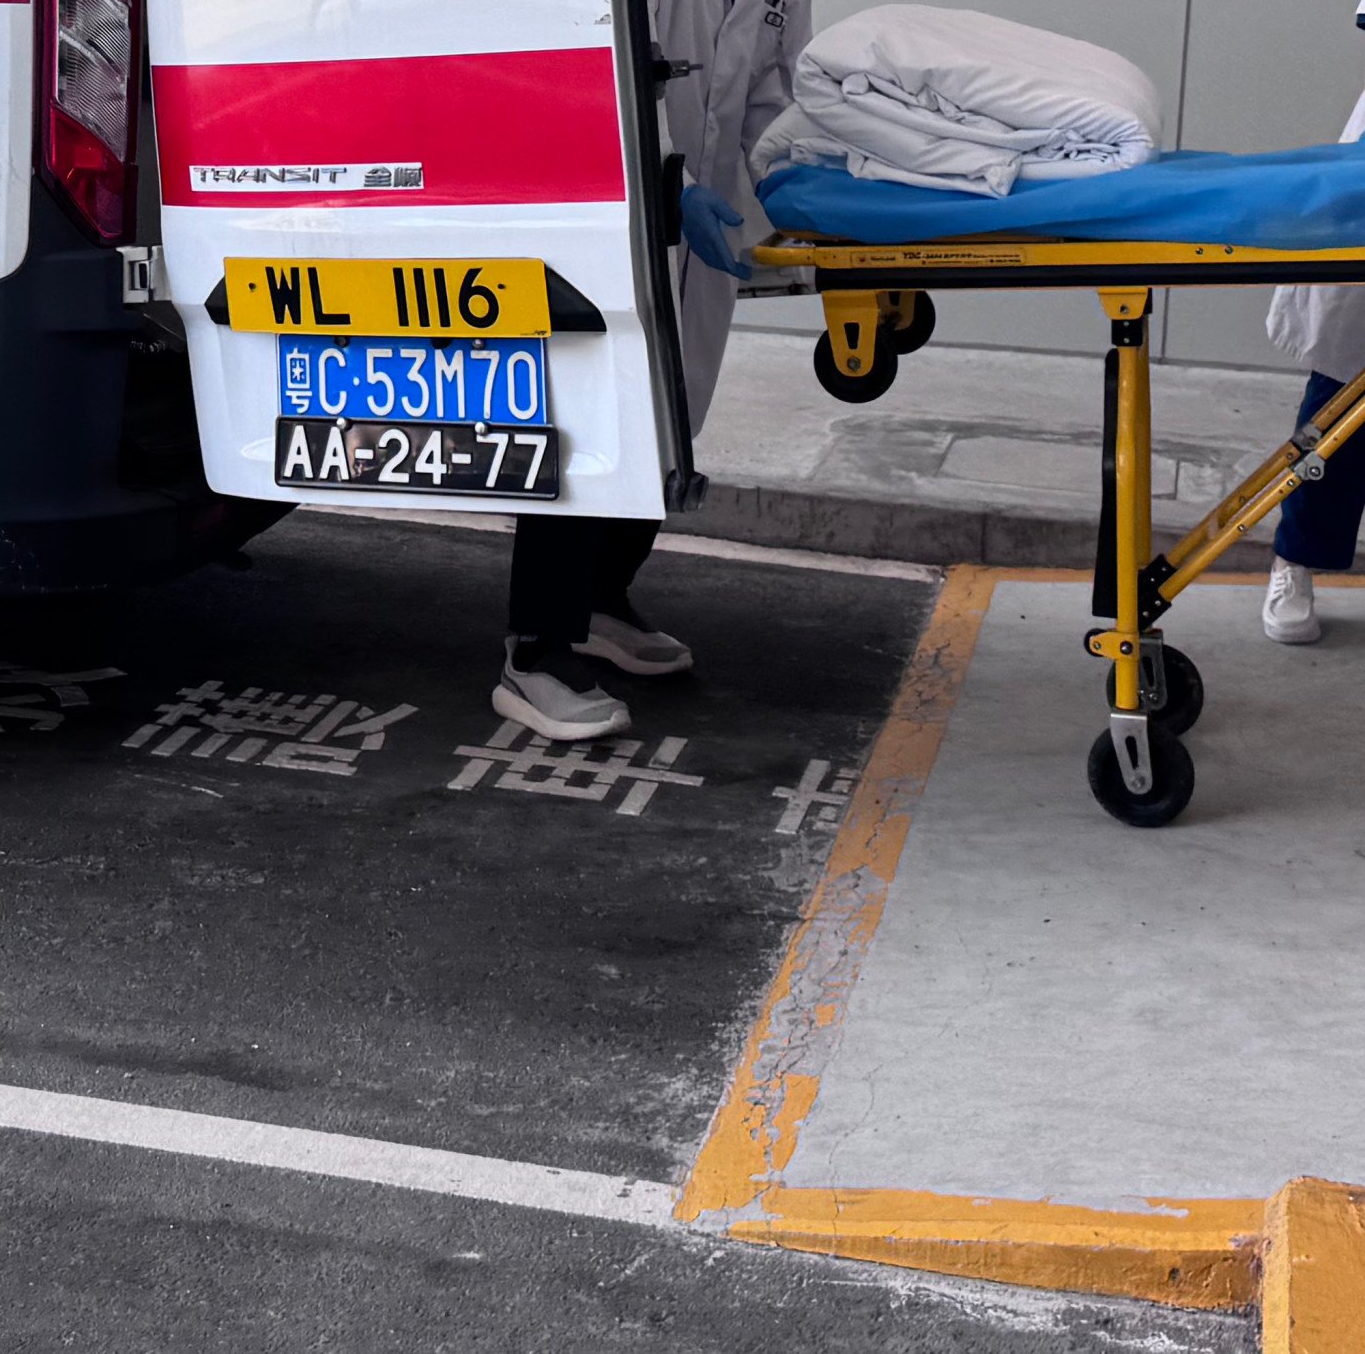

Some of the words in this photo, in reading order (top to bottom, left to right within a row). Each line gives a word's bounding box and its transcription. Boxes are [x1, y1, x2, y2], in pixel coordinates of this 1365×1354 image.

[193, 166, 347, 184] TRANSIT
[265, 266, 351, 325] WL
[392, 267, 500, 328] 1116
[283, 425, 548, 490] AA-24-77
